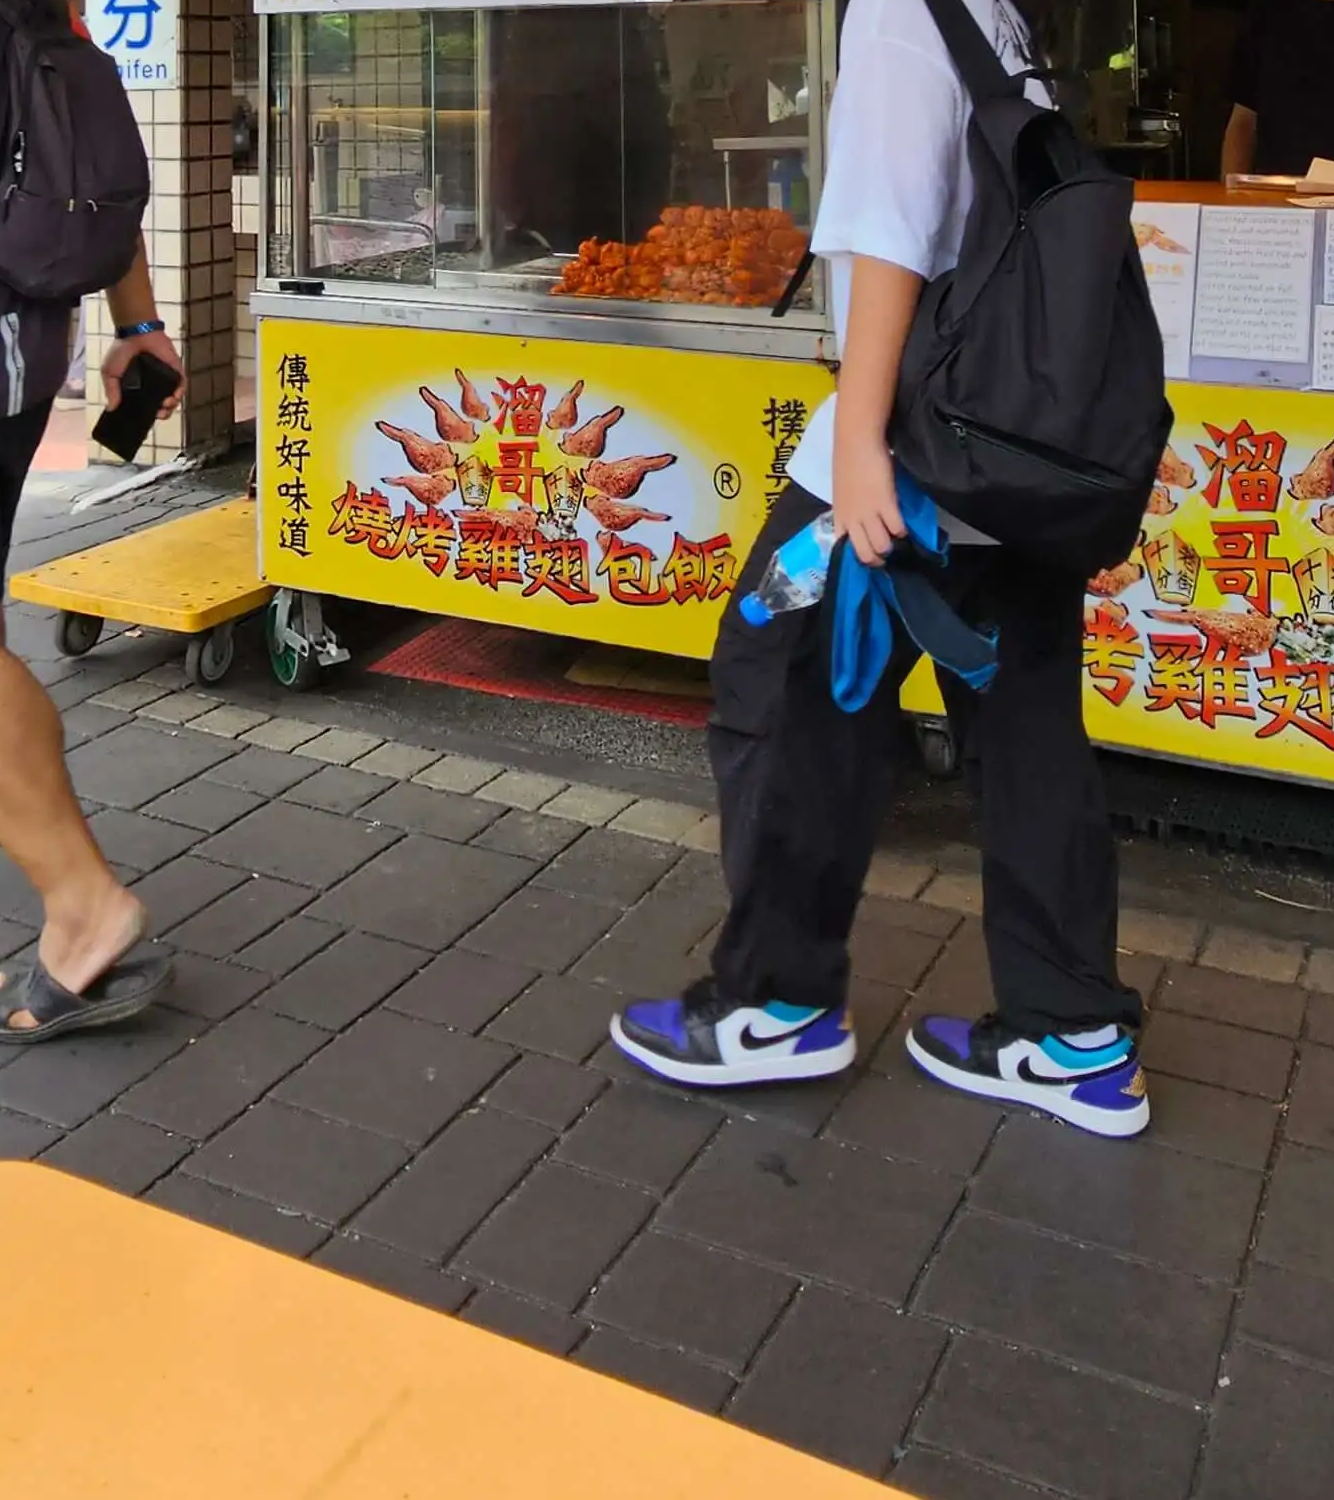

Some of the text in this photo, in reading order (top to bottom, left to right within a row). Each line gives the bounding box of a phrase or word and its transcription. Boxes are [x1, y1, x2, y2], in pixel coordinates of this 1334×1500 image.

[276, 353, 313, 558] 傳統好味道
[491, 375, 548, 502] 溜哥
[1195, 419, 1293, 618] 溜哥
[327, 479, 739, 606] 燒烤雞翅包飯
